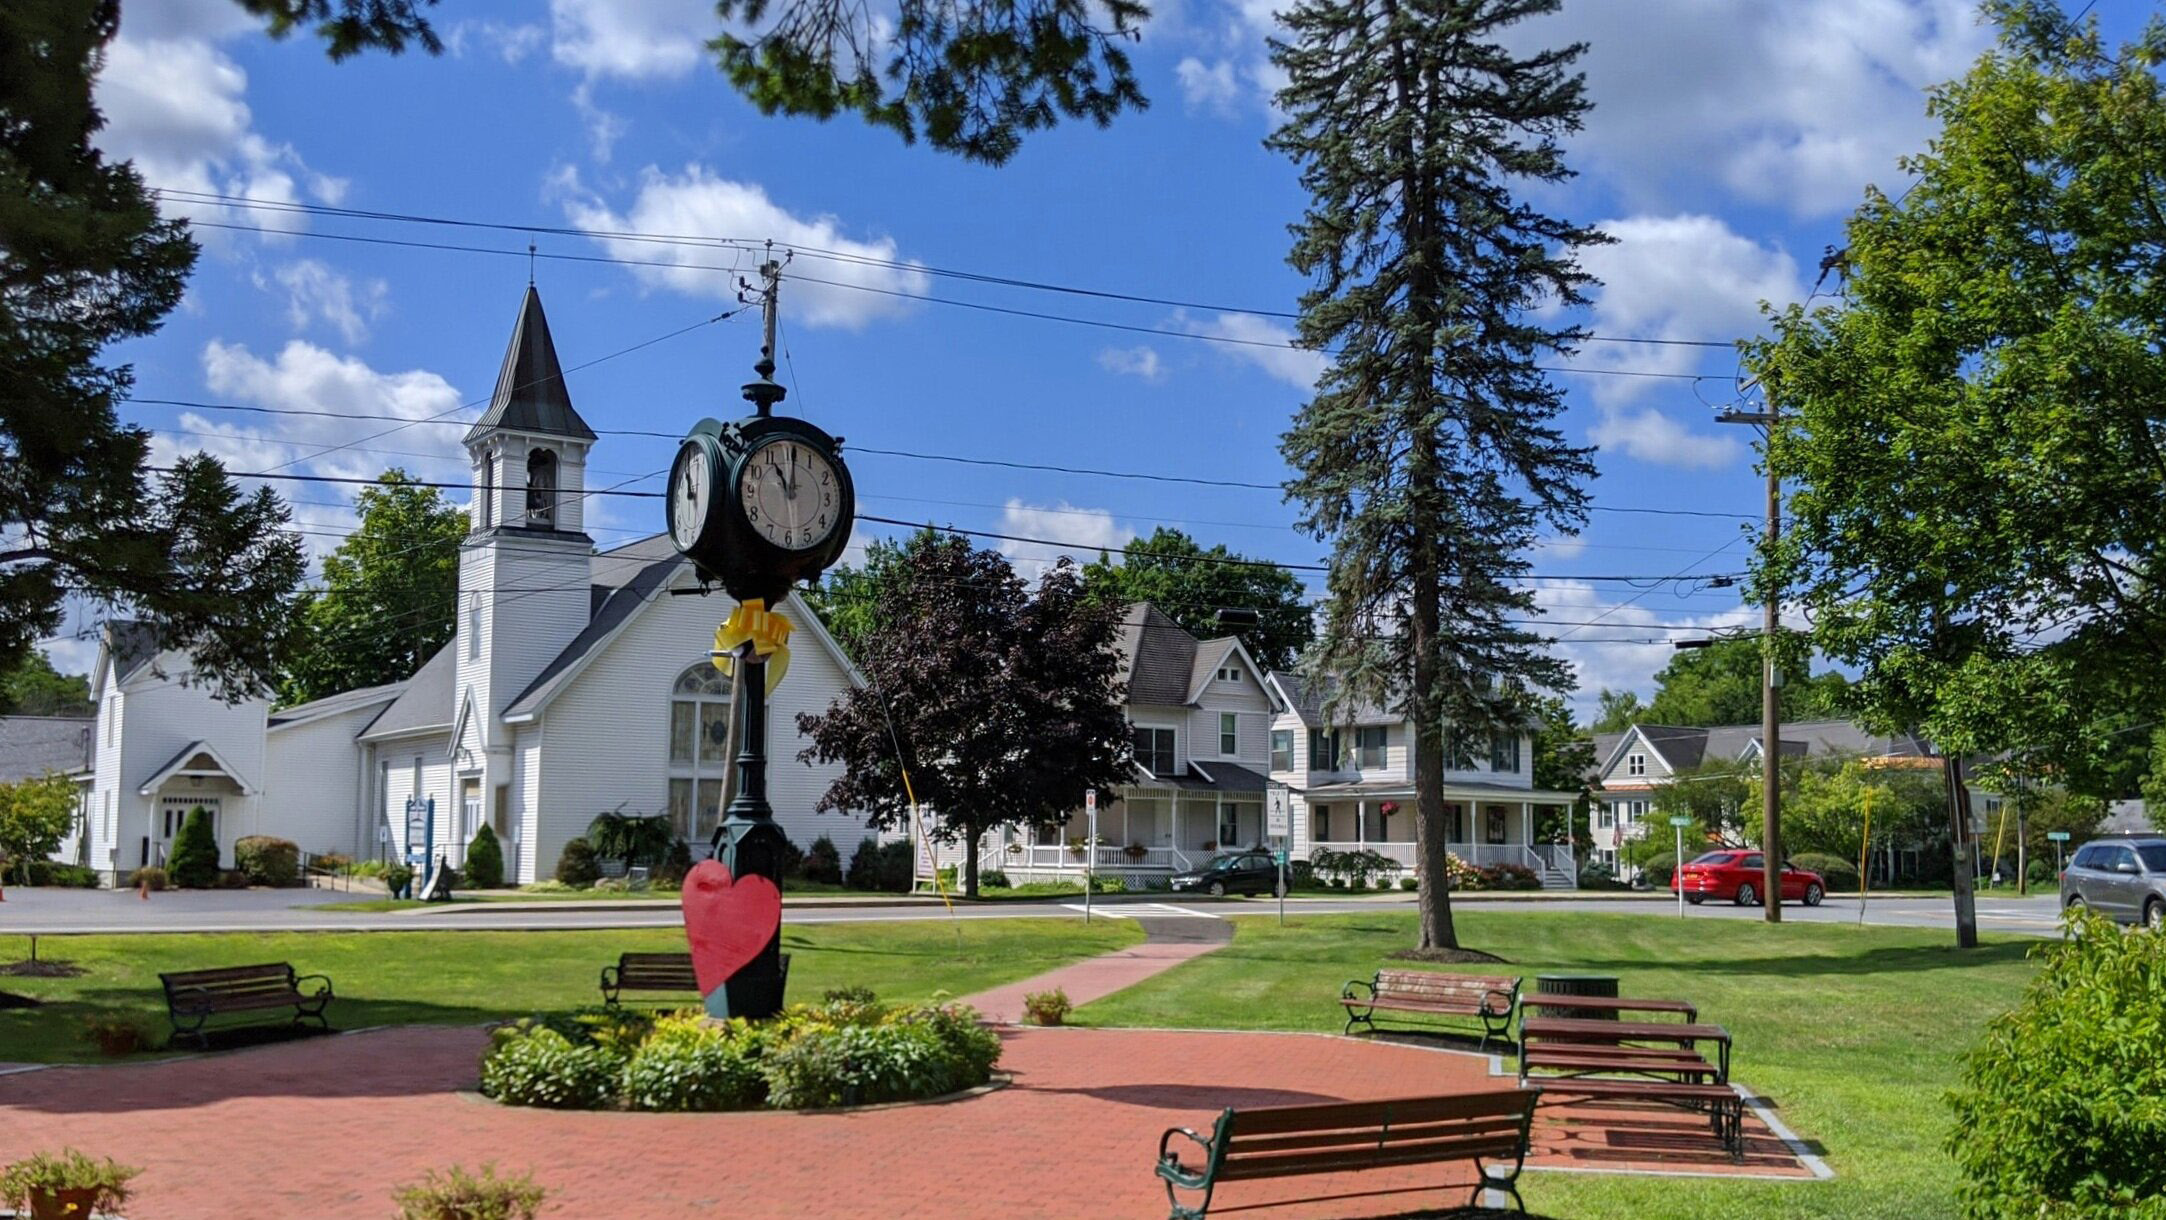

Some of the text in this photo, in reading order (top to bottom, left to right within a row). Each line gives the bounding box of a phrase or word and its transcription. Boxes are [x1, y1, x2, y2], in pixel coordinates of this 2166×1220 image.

[765, 447, 774, 465] 11
[807, 454, 812, 469] 1
[750, 465, 762, 480] 10
[822, 471, 829, 486] 2
[747, 485, 755, 499] 9
[823, 493, 831, 507] 3
[749, 506, 758, 521] 8
[818, 513, 826, 529] 4
[766, 524, 774, 540] 7
[785, 530, 792, 545] 6
[803, 528, 812, 543] 5
